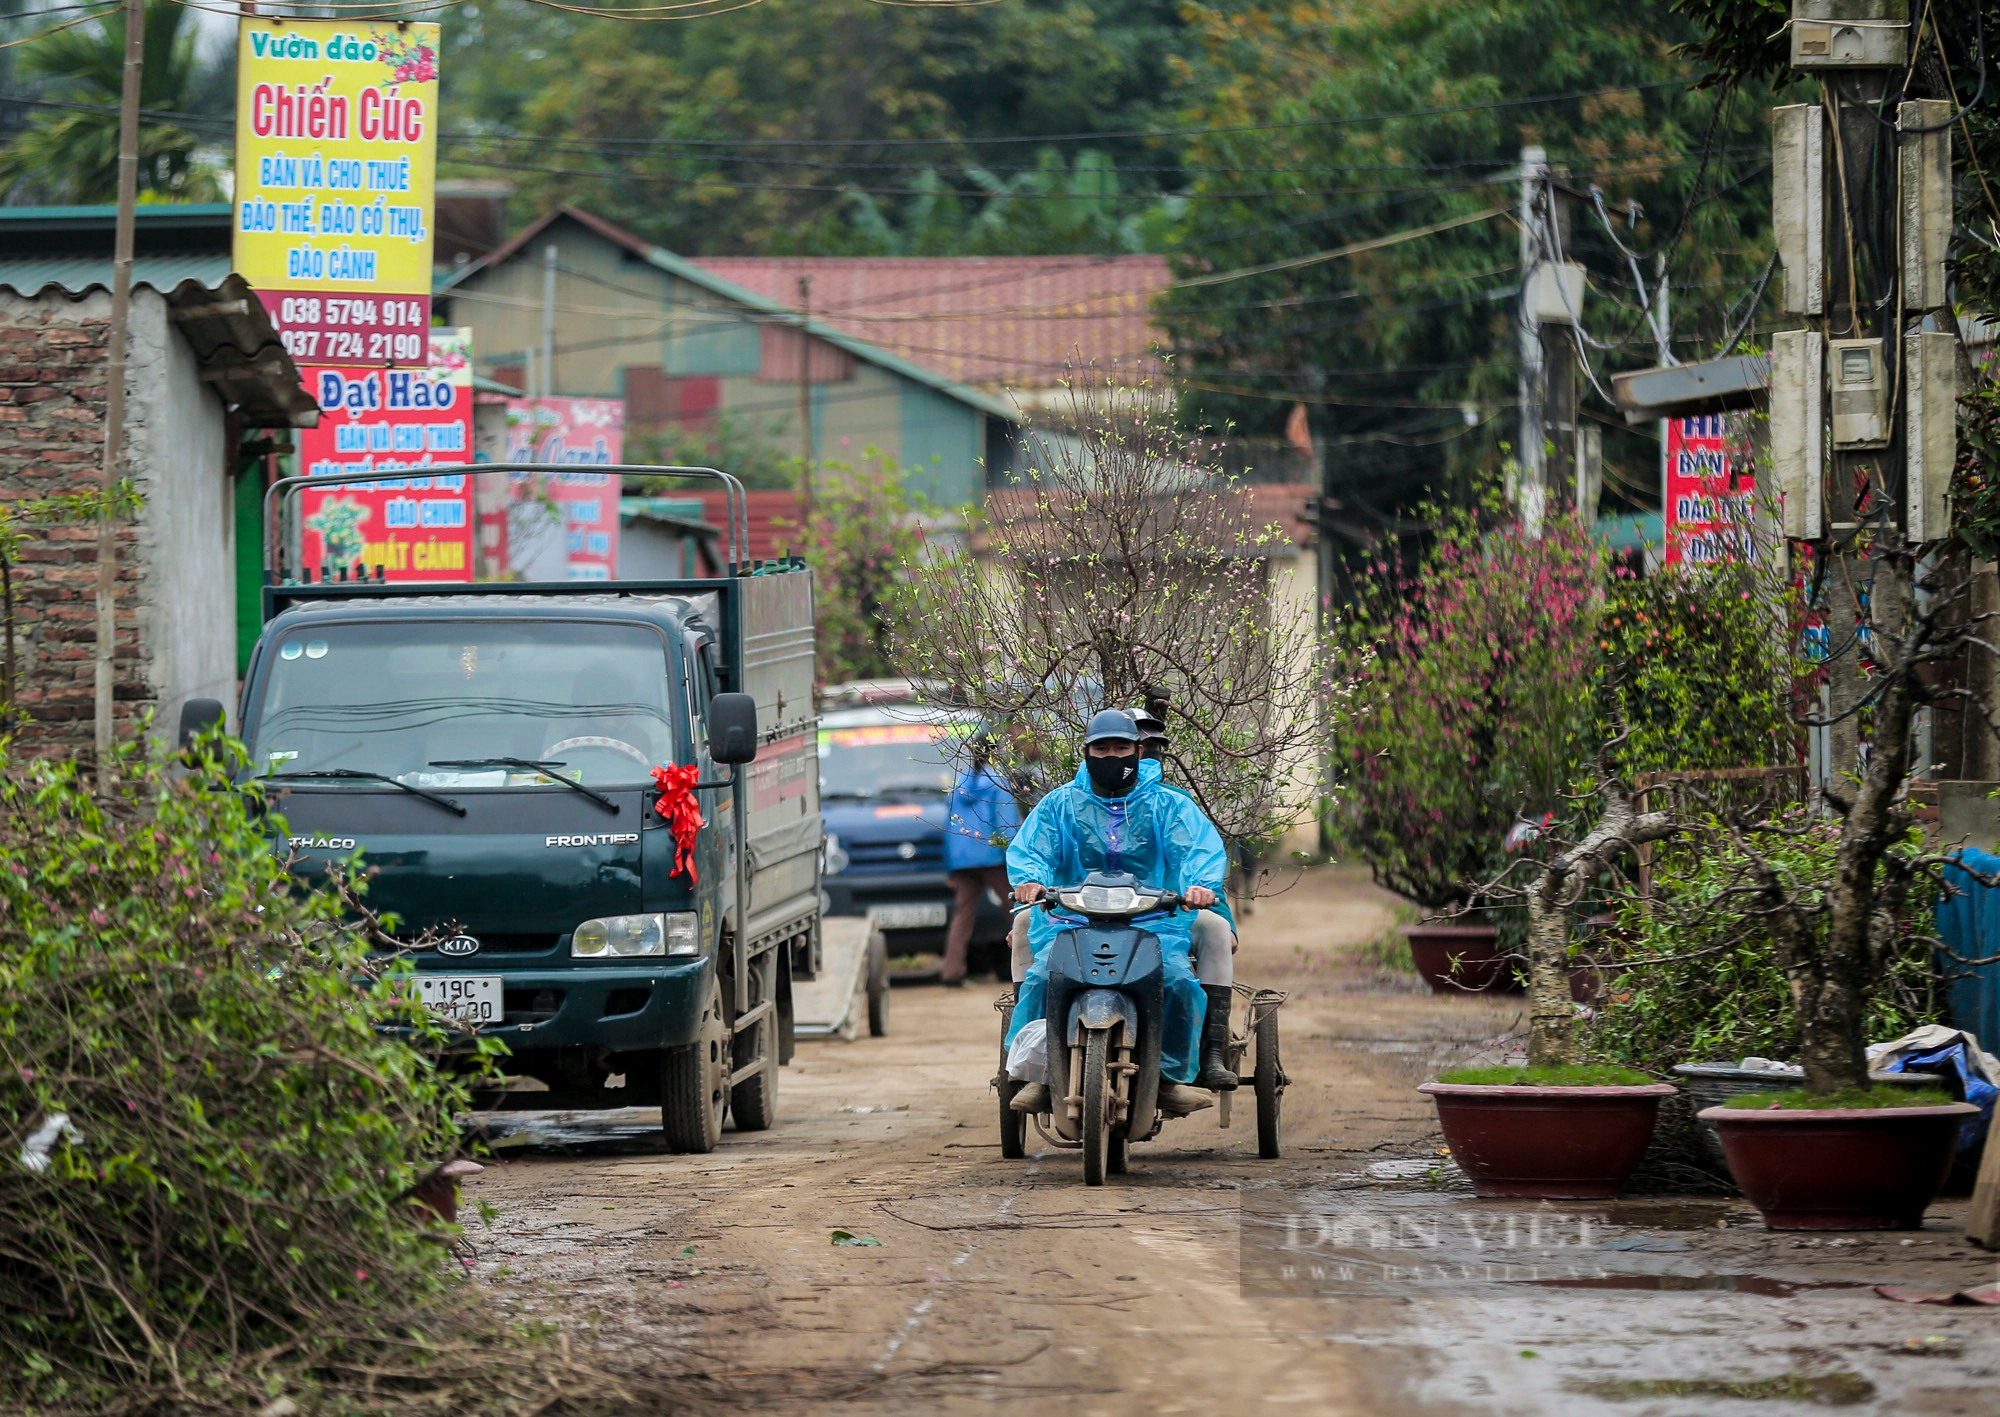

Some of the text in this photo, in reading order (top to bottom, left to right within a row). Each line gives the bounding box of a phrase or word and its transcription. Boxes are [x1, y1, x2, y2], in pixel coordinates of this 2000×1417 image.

[251, 31, 378, 61] Vườn đào
[253, 77, 423, 142] Chiến Cúc
[261, 152, 410, 190] BÁN VÀ CHO THUÊ
[241, 198, 275, 232] ĐÀO
[321, 198, 355, 234] ĐÀO
[289, 244, 323, 279] ĐÀO
[281, 297, 422, 327] 038 5794 914
[280, 330, 421, 360] 037 724 2190
[321, 372, 379, 416] Đạt
[289, 833, 639, 850] THACO FRONTIER
[444, 939, 473, 952] KIA
[440, 980, 475, 998] 19C
